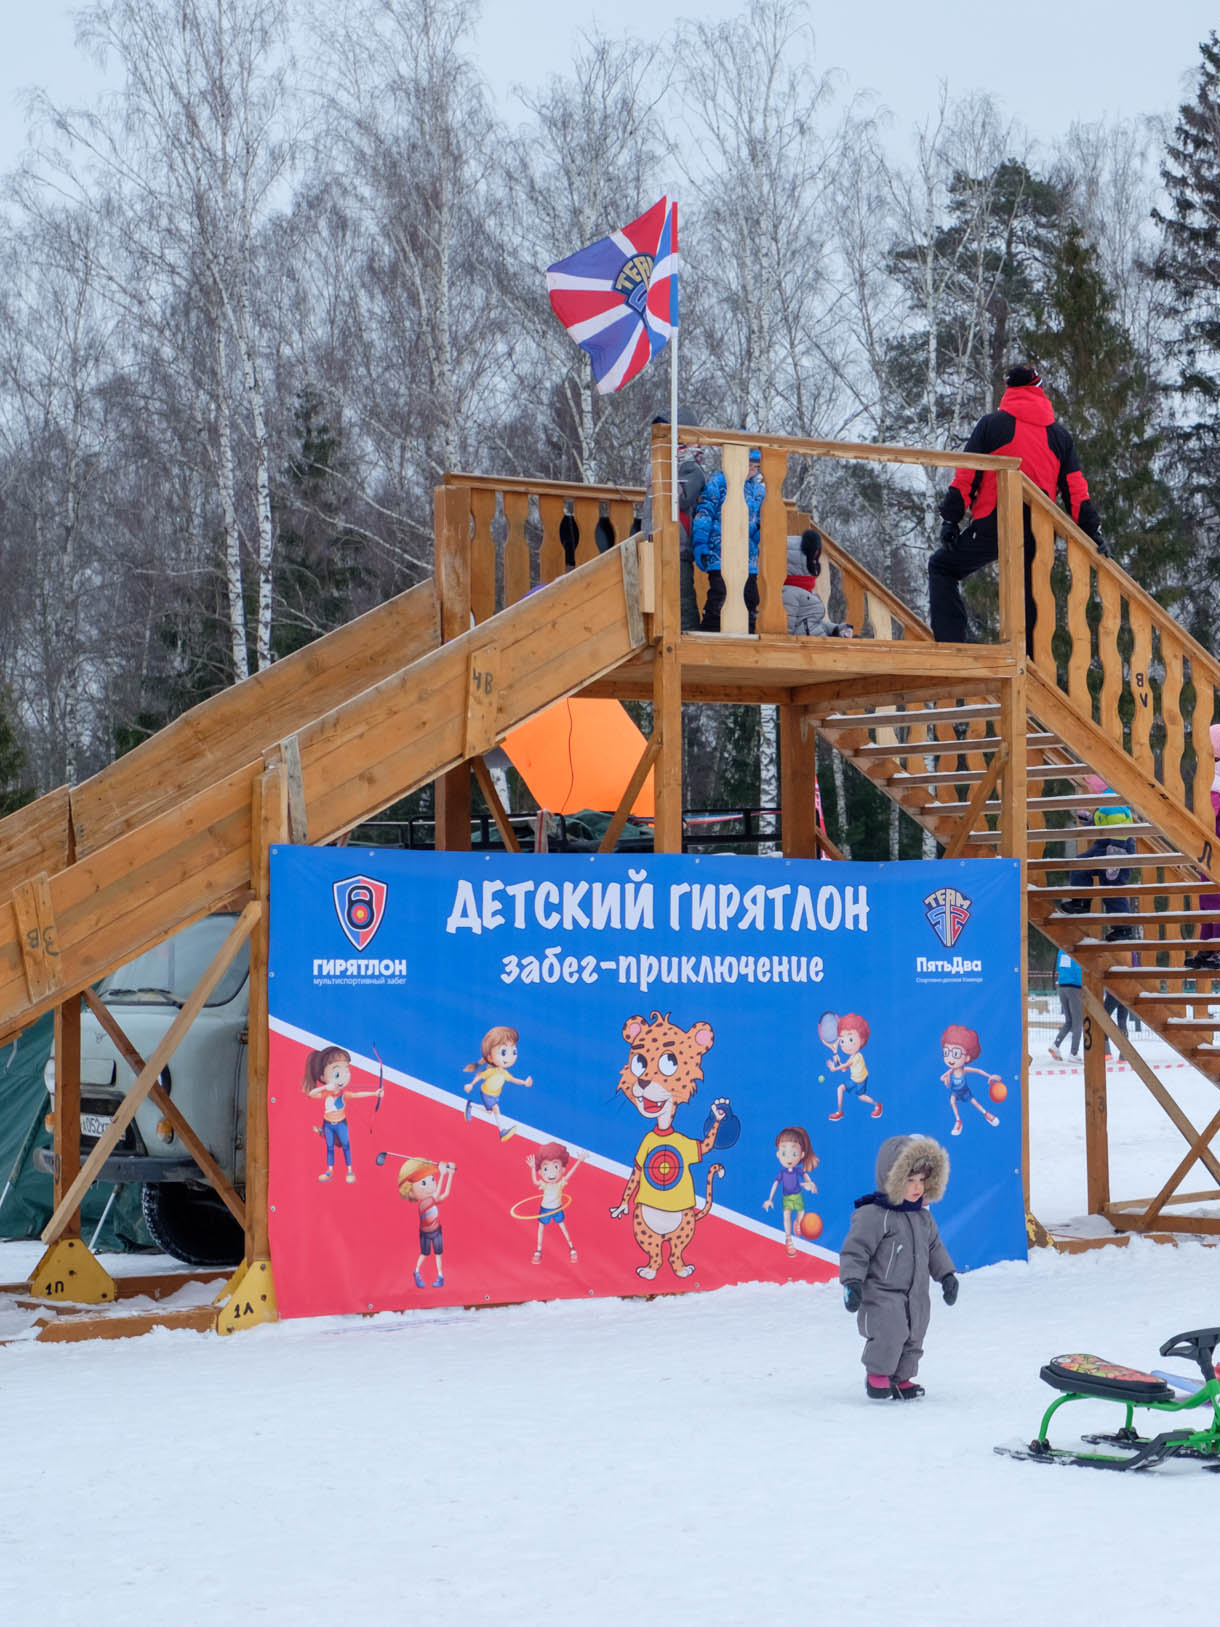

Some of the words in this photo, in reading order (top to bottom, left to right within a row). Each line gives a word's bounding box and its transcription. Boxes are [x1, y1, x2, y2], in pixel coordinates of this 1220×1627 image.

[445, 868, 655, 935] ДЕТСКИЙ
[669, 881, 870, 933] ГИРЯТЛОН
[924, 888, 972, 910] TEAM
[312, 959, 407, 976] ГИРЯТЛОН
[501, 946, 825, 993] забег-приключение
[916, 956, 982, 974] ПятьДва
[386, 976, 407, 985] забег
